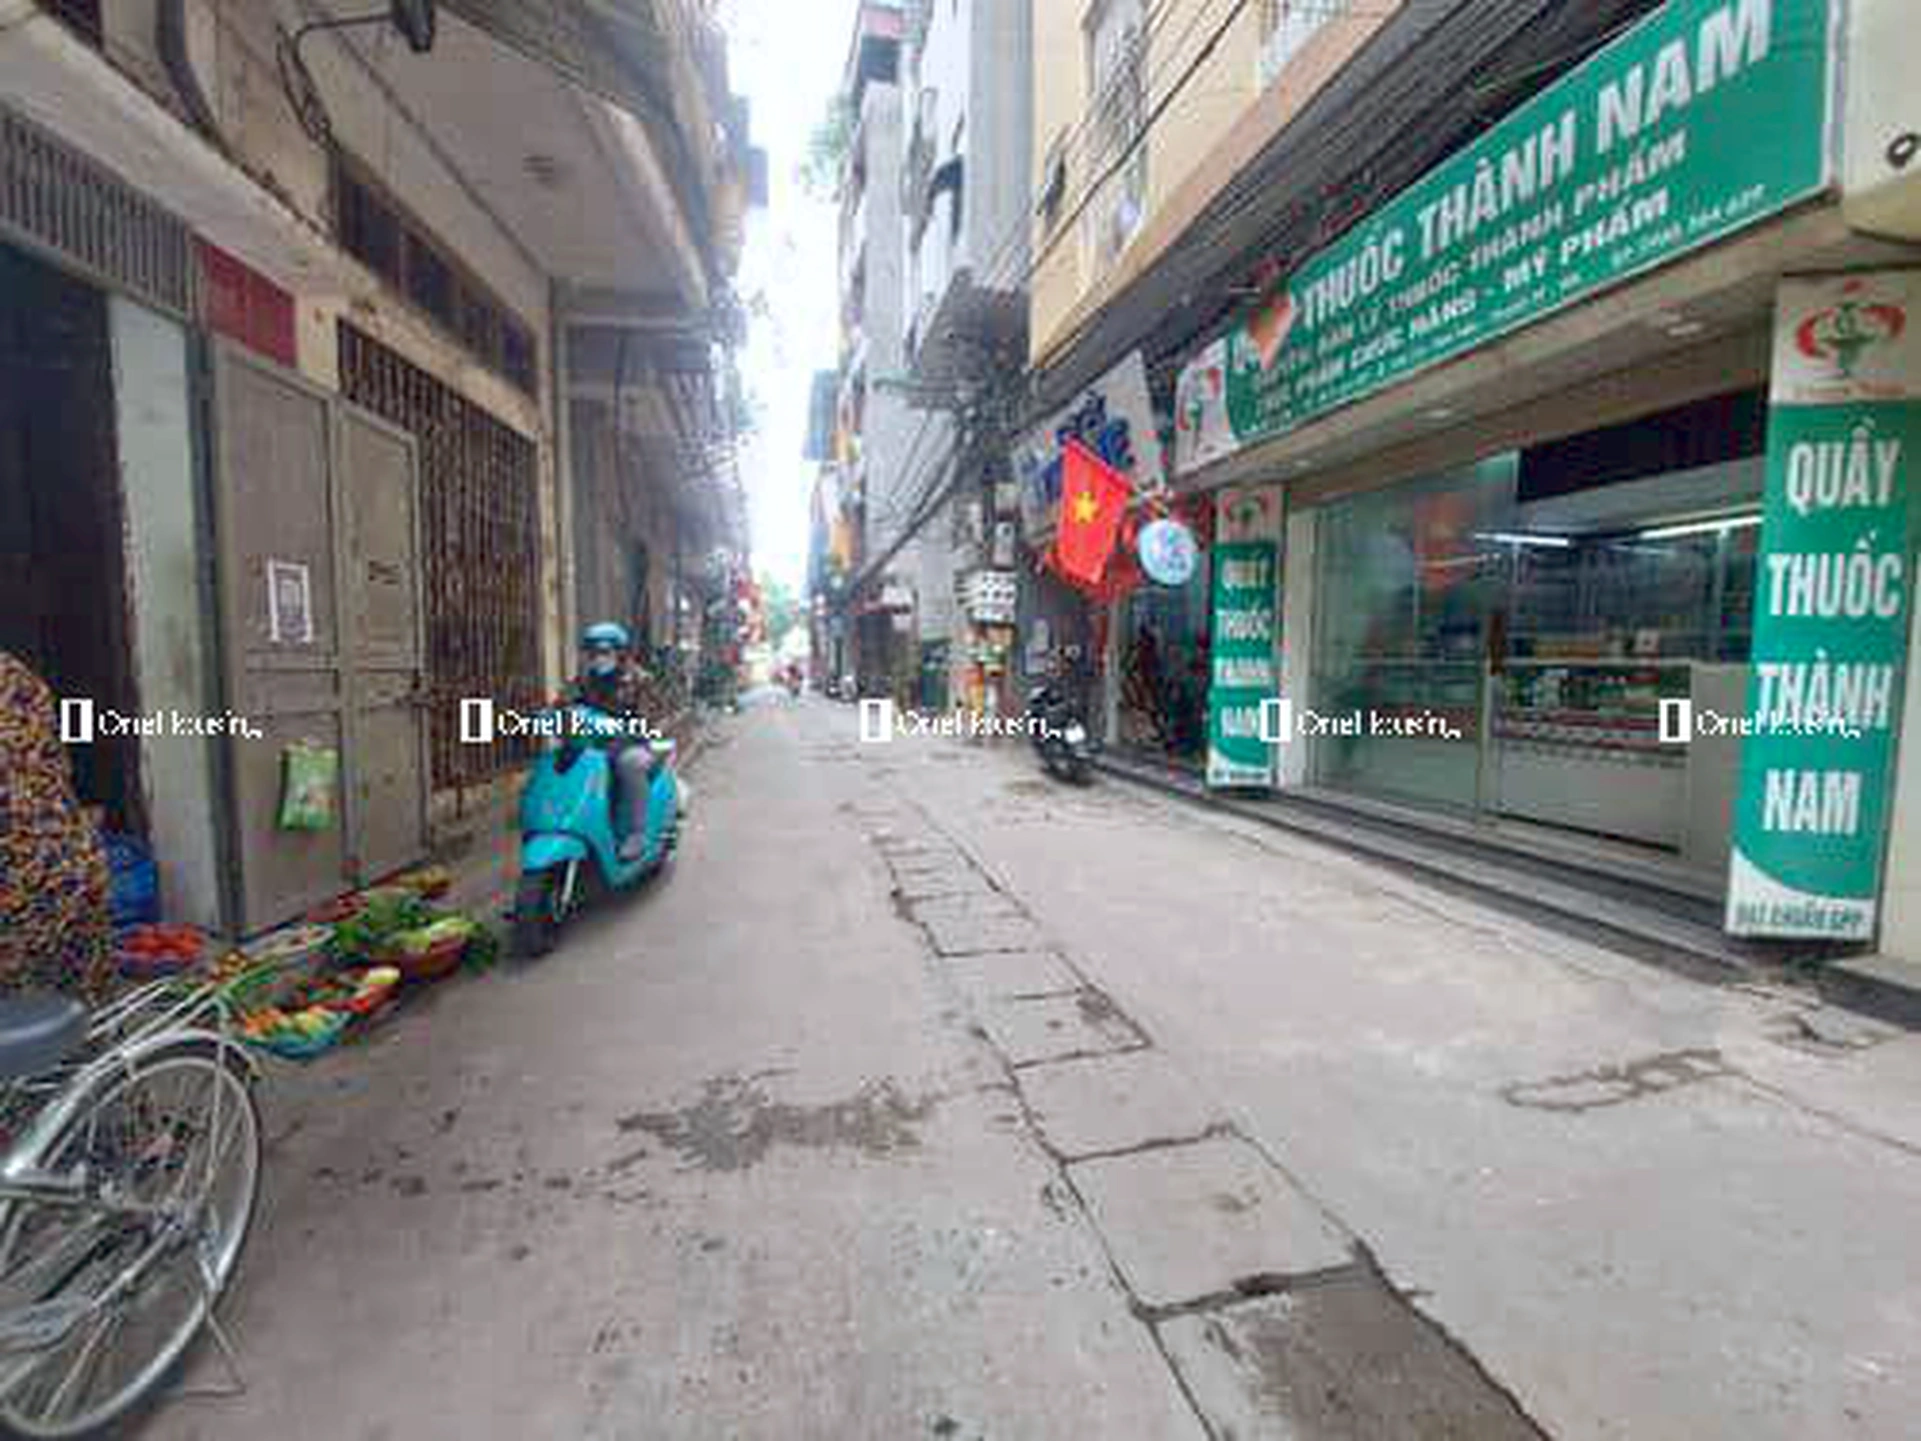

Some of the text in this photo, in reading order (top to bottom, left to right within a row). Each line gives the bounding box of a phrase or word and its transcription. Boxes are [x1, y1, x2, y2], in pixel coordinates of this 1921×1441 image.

[1302, 224, 1404, 328] THUỐC
[1415, 111, 1576, 259] THÀNH
[1597, 0, 1771, 154] NAM
[1786, 416, 1901, 516] QUẦY
[1767, 528, 1902, 616] THUỐC
[1756, 646, 1893, 729] THÀNH
[1763, 768, 1862, 834] NAM
